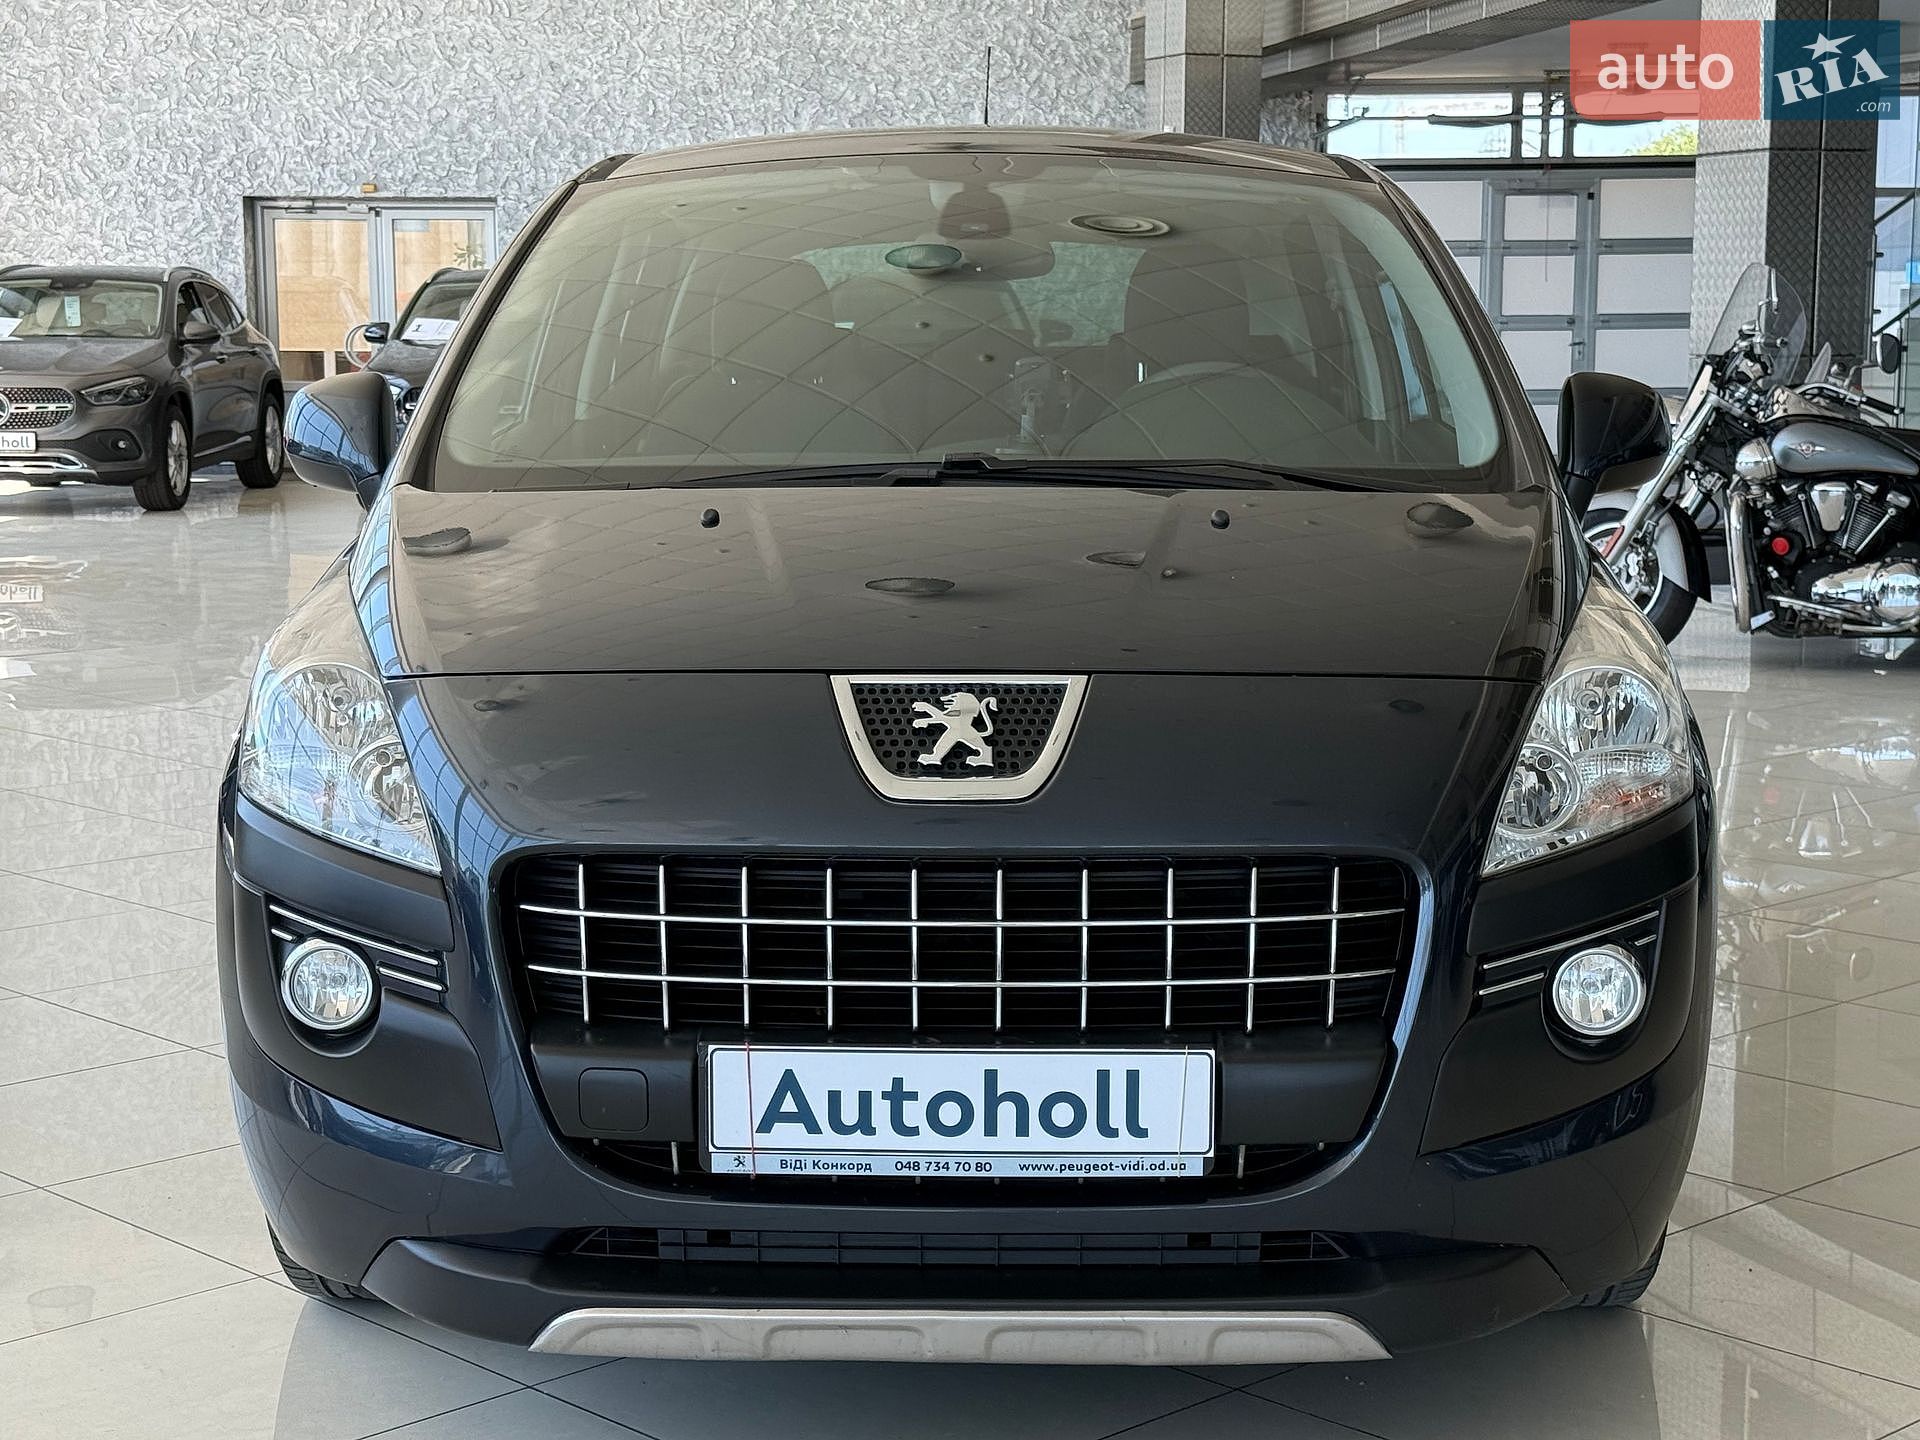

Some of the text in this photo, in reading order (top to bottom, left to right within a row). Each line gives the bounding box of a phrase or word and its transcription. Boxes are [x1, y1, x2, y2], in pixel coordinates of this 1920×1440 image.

[755, 1068, 1149, 1139] Autoholl
[812, 1159, 873, 1172] Конкорд
[895, 1160, 921, 1172] 048
[925, 1161, 951, 1172] 734
[954, 1161, 972, 1172] 70
[975, 1161, 993, 1173] 80
[1018, 1159, 1187, 1174] www.peugeot-vidi.od.ua
